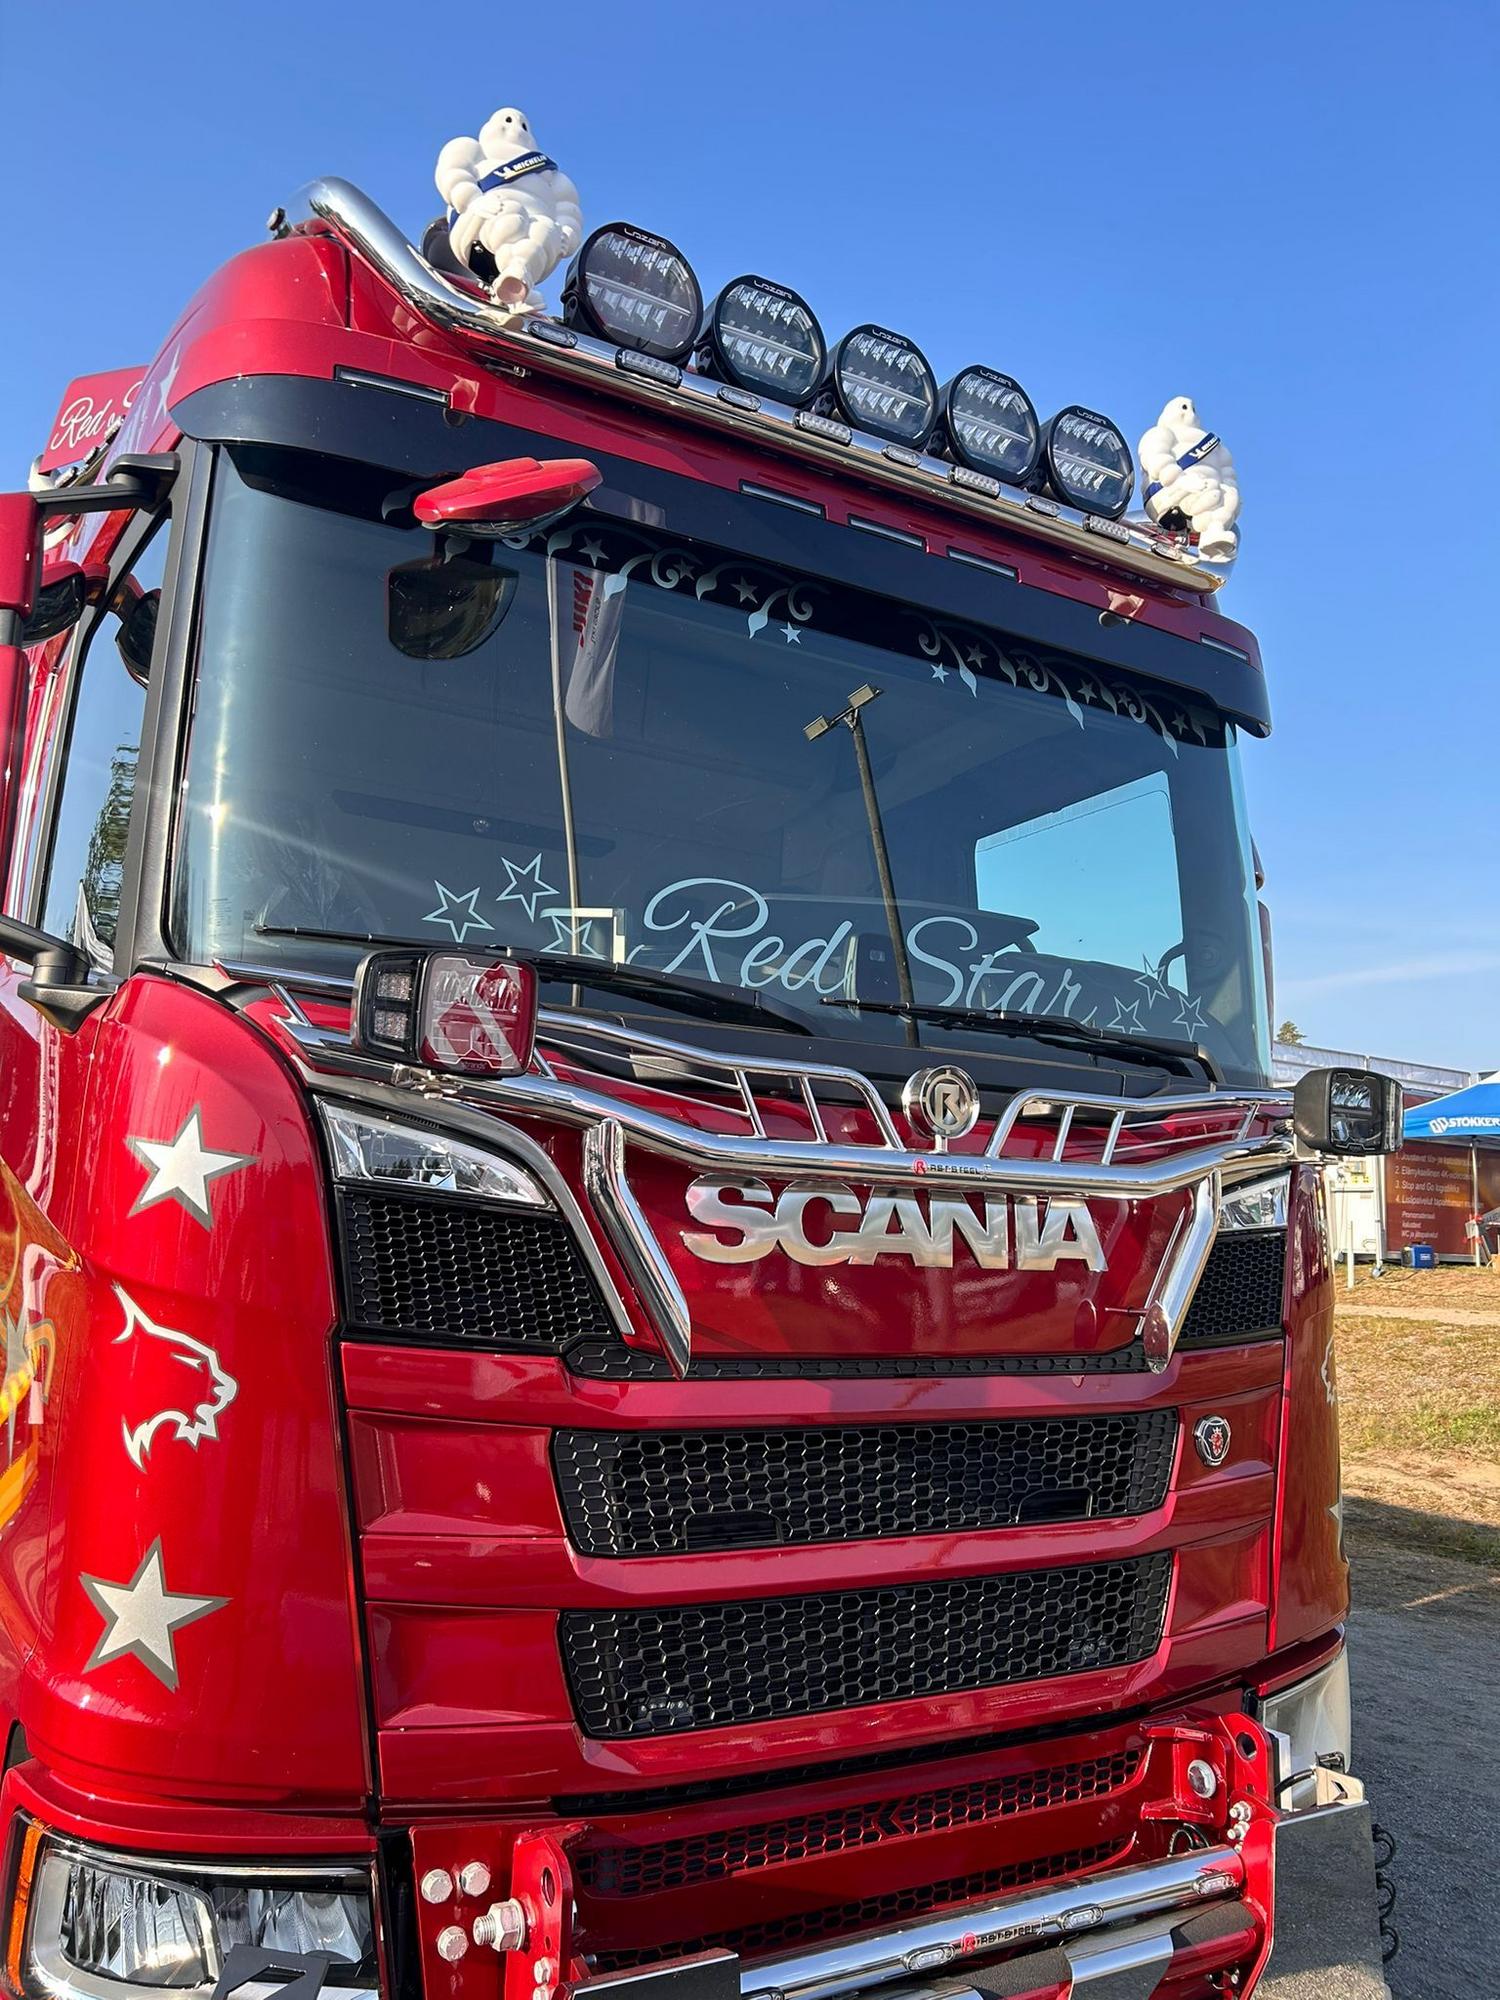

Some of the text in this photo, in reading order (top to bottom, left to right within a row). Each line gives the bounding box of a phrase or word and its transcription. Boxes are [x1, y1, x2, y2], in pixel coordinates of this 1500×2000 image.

[51, 397, 112, 450] Red
[626, 878, 1098, 1024] Red Star
[680, 1173, 1109, 1273] SCANIA
[1401, 1180, 1414, 1191] Stop
[1415, 1182, 1425, 1190] and
[1426, 1182, 1434, 1190] Go
